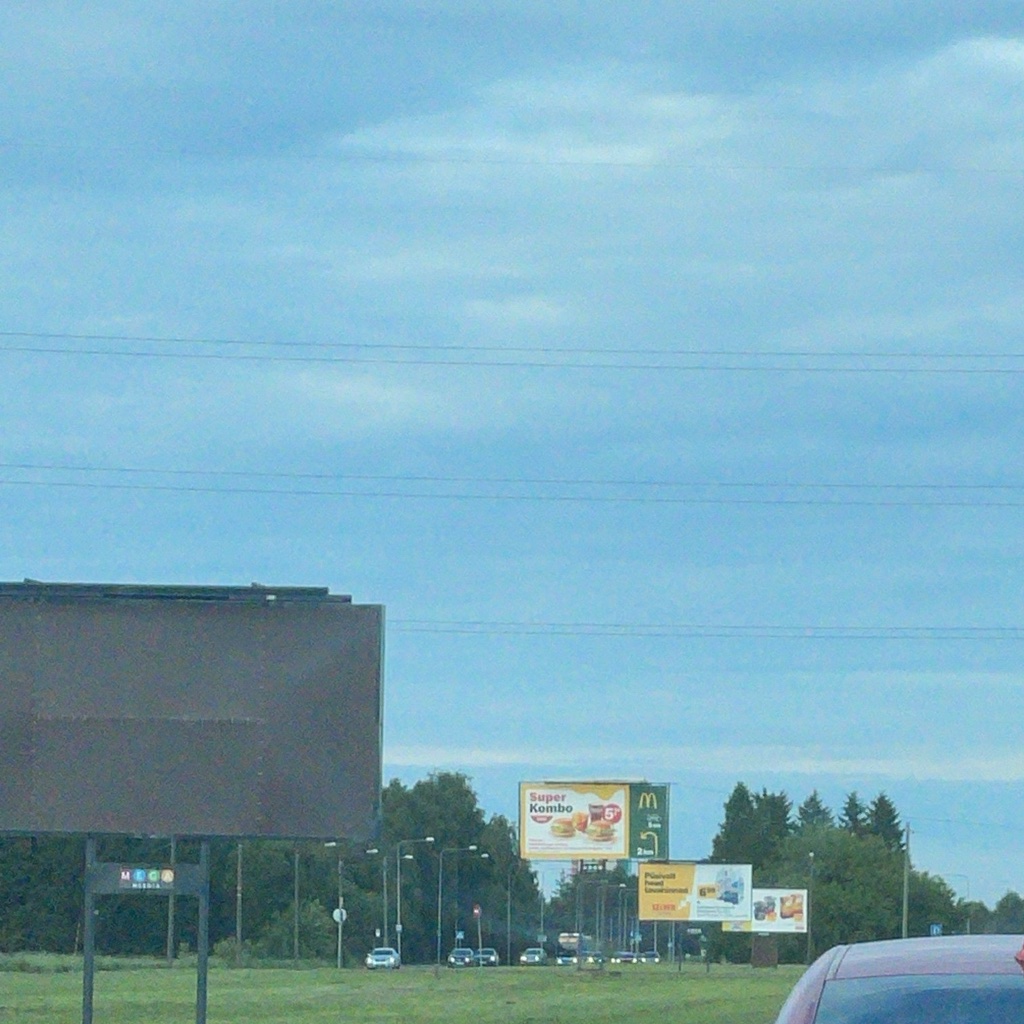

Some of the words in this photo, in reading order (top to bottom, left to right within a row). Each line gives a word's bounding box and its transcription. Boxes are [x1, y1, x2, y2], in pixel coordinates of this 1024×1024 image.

[529, 792, 567, 803] Super
[529, 803, 573, 813] Kombo
[637, 847, 642, 855] 2
[120, 869, 174, 882] MEGA
